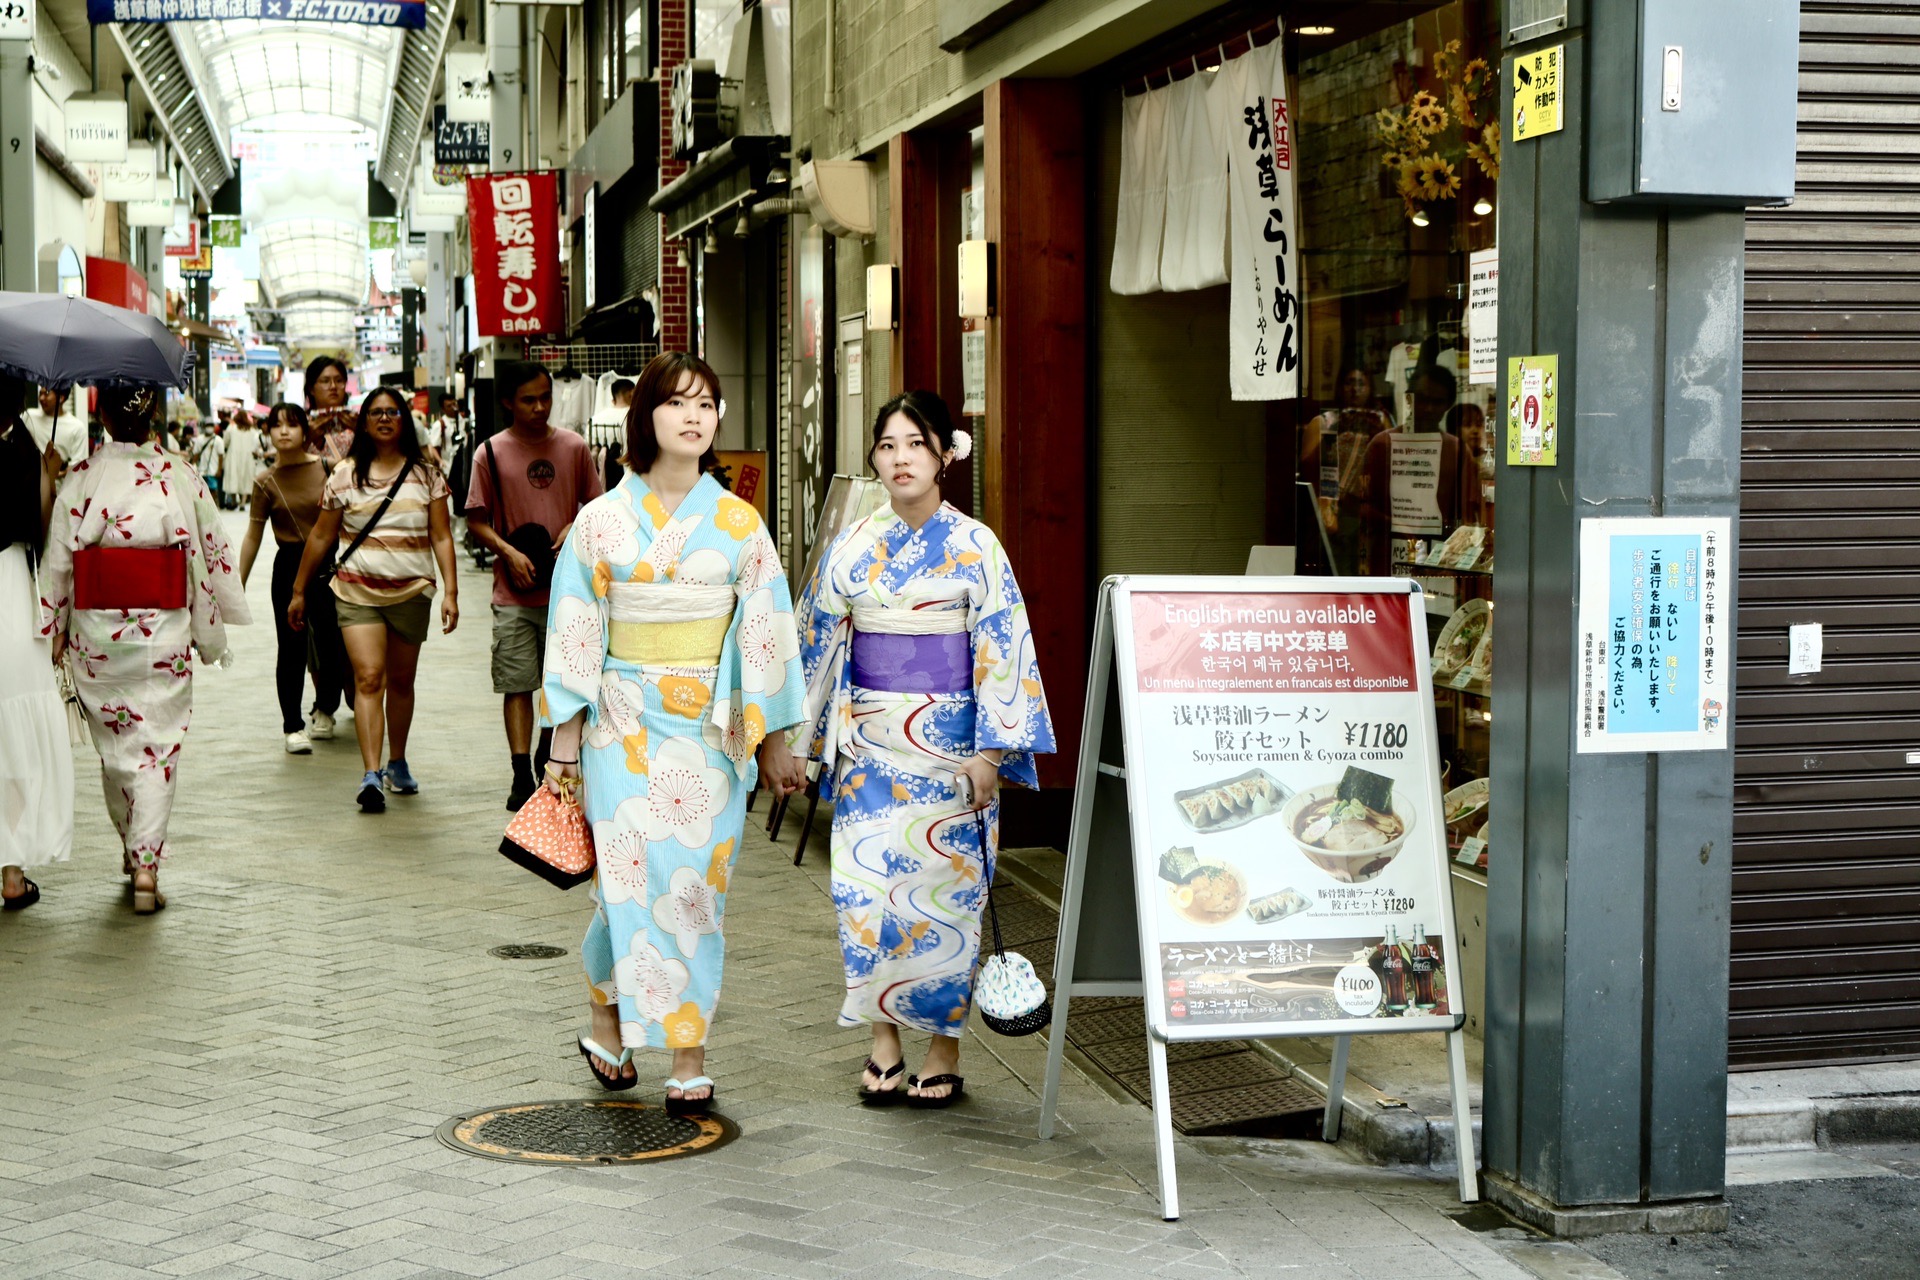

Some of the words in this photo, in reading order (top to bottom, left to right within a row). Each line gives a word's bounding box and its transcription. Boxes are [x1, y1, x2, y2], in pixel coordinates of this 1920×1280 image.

[1535, 72, 1555, 89] カメラ
[1535, 91, 1555, 109] 作動中
[69, 128, 119, 140] TSUTSUMI
[438, 120, 489, 146] たんす屋
[10, 138, 20, 153] 9
[503, 149, 513, 163] 9
[1244, 96, 1297, 373] 浅草らーめん
[490, 178, 537, 314] 回転寿し
[502, 317, 541, 332] 日向丸
[1667, 562, 1679, 589] 徐行
[1685, 549, 1697, 601] 自転車は
[1165, 603, 1232, 628] English
[1237, 609, 1290, 624] menu
[1296, 604, 1376, 624] available
[1667, 603, 1678, 641] ないし
[1200, 630, 1348, 652] 本店有中文菜单
[1649, 550, 1662, 714] ご通行をお願いいたします。
[1201, 655, 1247, 673] 한국어
[1252, 655, 1283, 673] 메뉴
[1288, 655, 1355, 673] 있습니다.
[1613, 617, 1625, 714] ご協力ください。
[1144, 677, 1160, 688] Un
[1163, 678, 1194, 689] menu
[1197, 677, 1273, 691] integralement
[1275, 678, 1289, 688] en
[1291, 676, 1332, 688] francais
[1335, 677, 1351, 688] est
[1353, 676, 1409, 690] disponible
[1666, 655, 1678, 695] 降りて
[1172, 705, 1331, 726] 浅草醤油ラーメン
[1215, 730, 1312, 750] 餃子セット
[1344, 721, 1408, 749] ¥1180
[1192, 750, 1253, 765] Soysauce
[1257, 752, 1300, 762] ramen
[1304, 750, 1314, 761] &
[1317, 749, 1357, 764] Gyoza
[1360, 749, 1404, 761] combo
[1332, 900, 1378, 910] 餃子セット
[1383, 898, 1415, 911] ¥1280
[1167, 942, 1313, 967] ラーメンと一緒に!
[1188, 980, 1230, 988] コカ・コーラ
[1341, 976, 1374, 991] ¥400
[1190, 1000, 1230, 1009] コカ・コーラ
